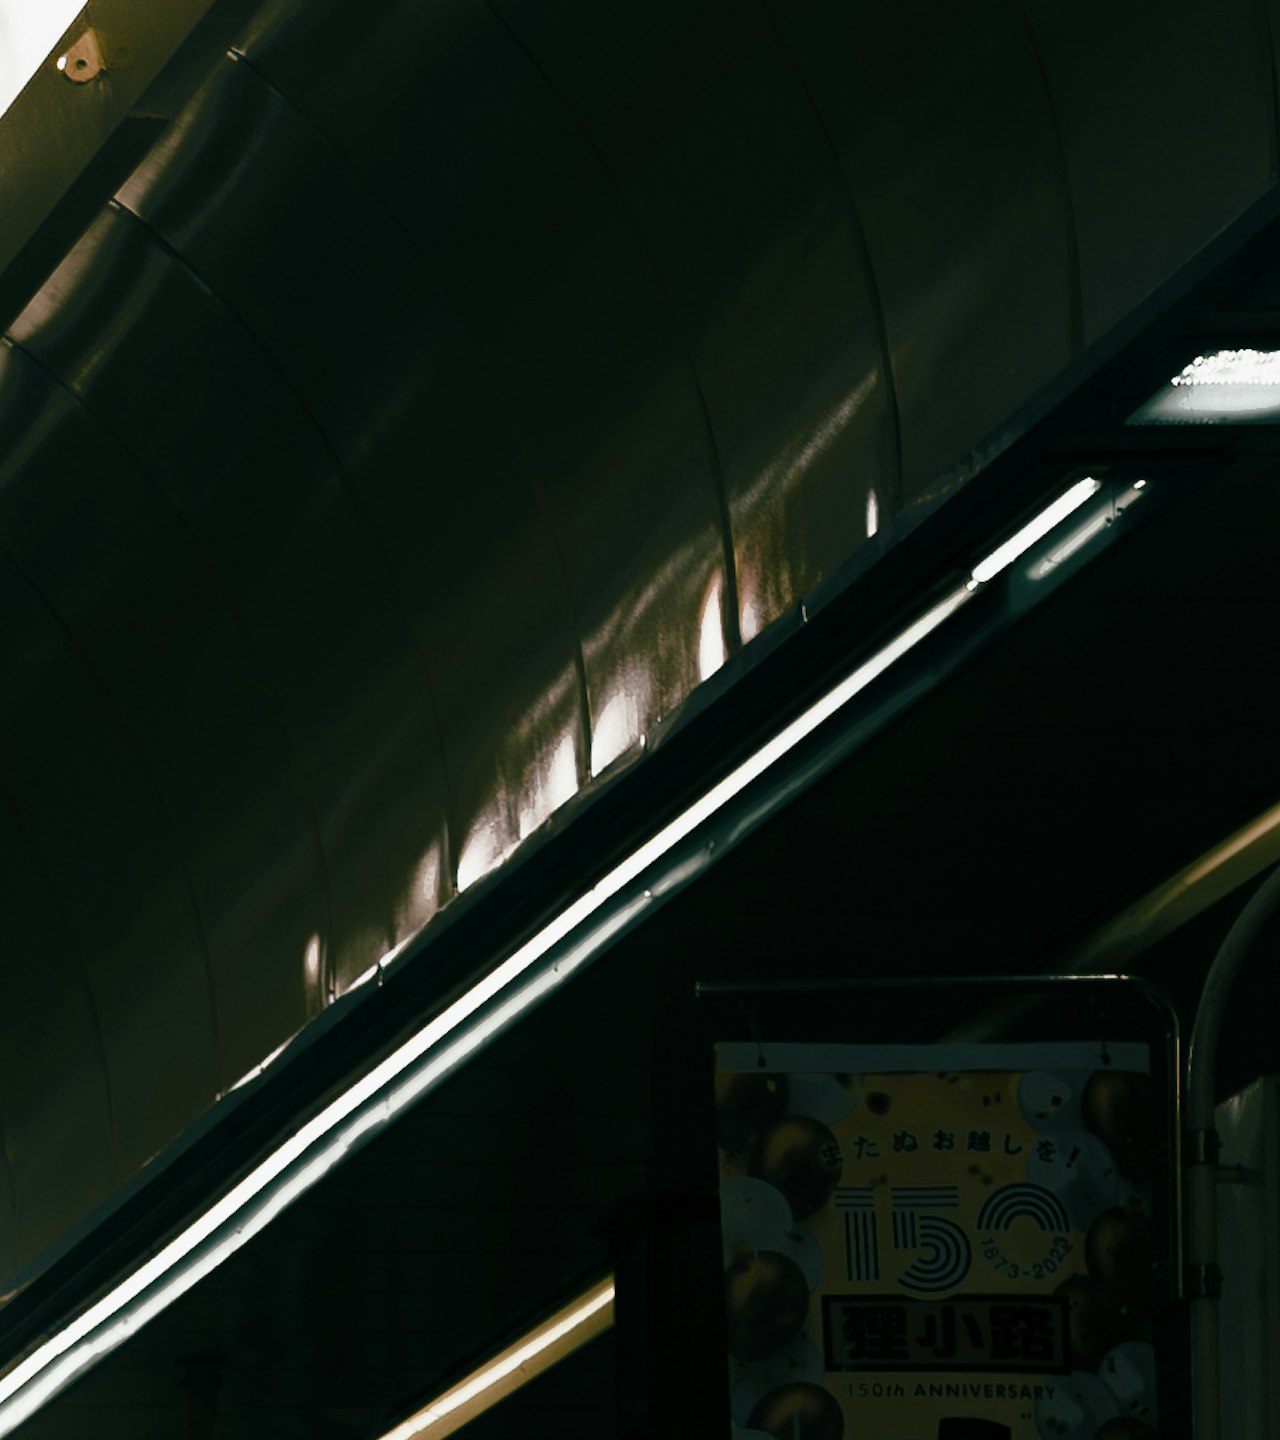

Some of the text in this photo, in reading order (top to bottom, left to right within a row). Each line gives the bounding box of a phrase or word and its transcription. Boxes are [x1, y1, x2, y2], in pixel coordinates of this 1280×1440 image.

[835, 1183, 1069, 1291] 150
[842, 1304, 1054, 1360] 狸小路
[849, 1382, 1056, 1401] 150th ANNIVERSARY
